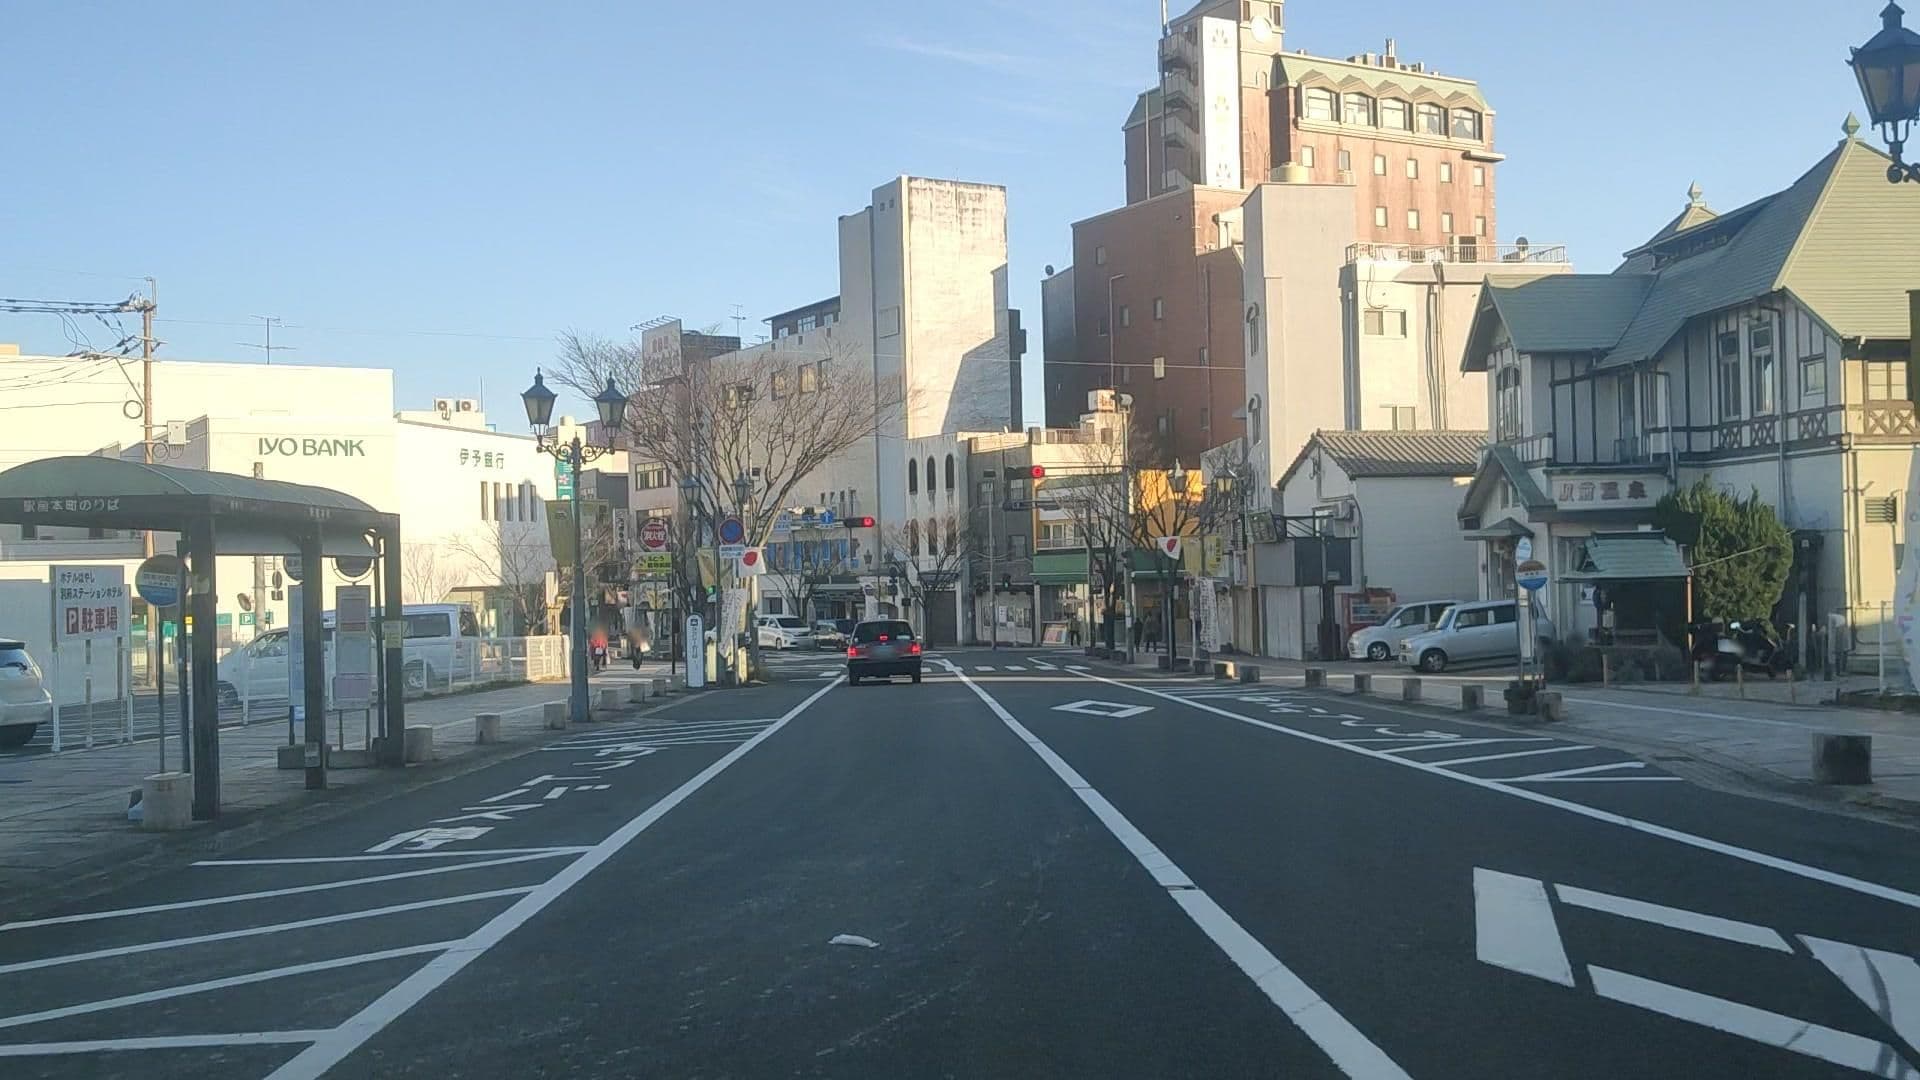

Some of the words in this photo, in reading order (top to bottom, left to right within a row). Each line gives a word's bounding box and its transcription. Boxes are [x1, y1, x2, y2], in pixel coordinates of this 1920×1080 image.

[258, 437, 298, 456] IYO
[302, 438, 366, 457] BANK
[459, 448, 505, 469] 伊予銀行
[67, 608, 78, 633] P
[81, 606, 118, 633] 駐車場
